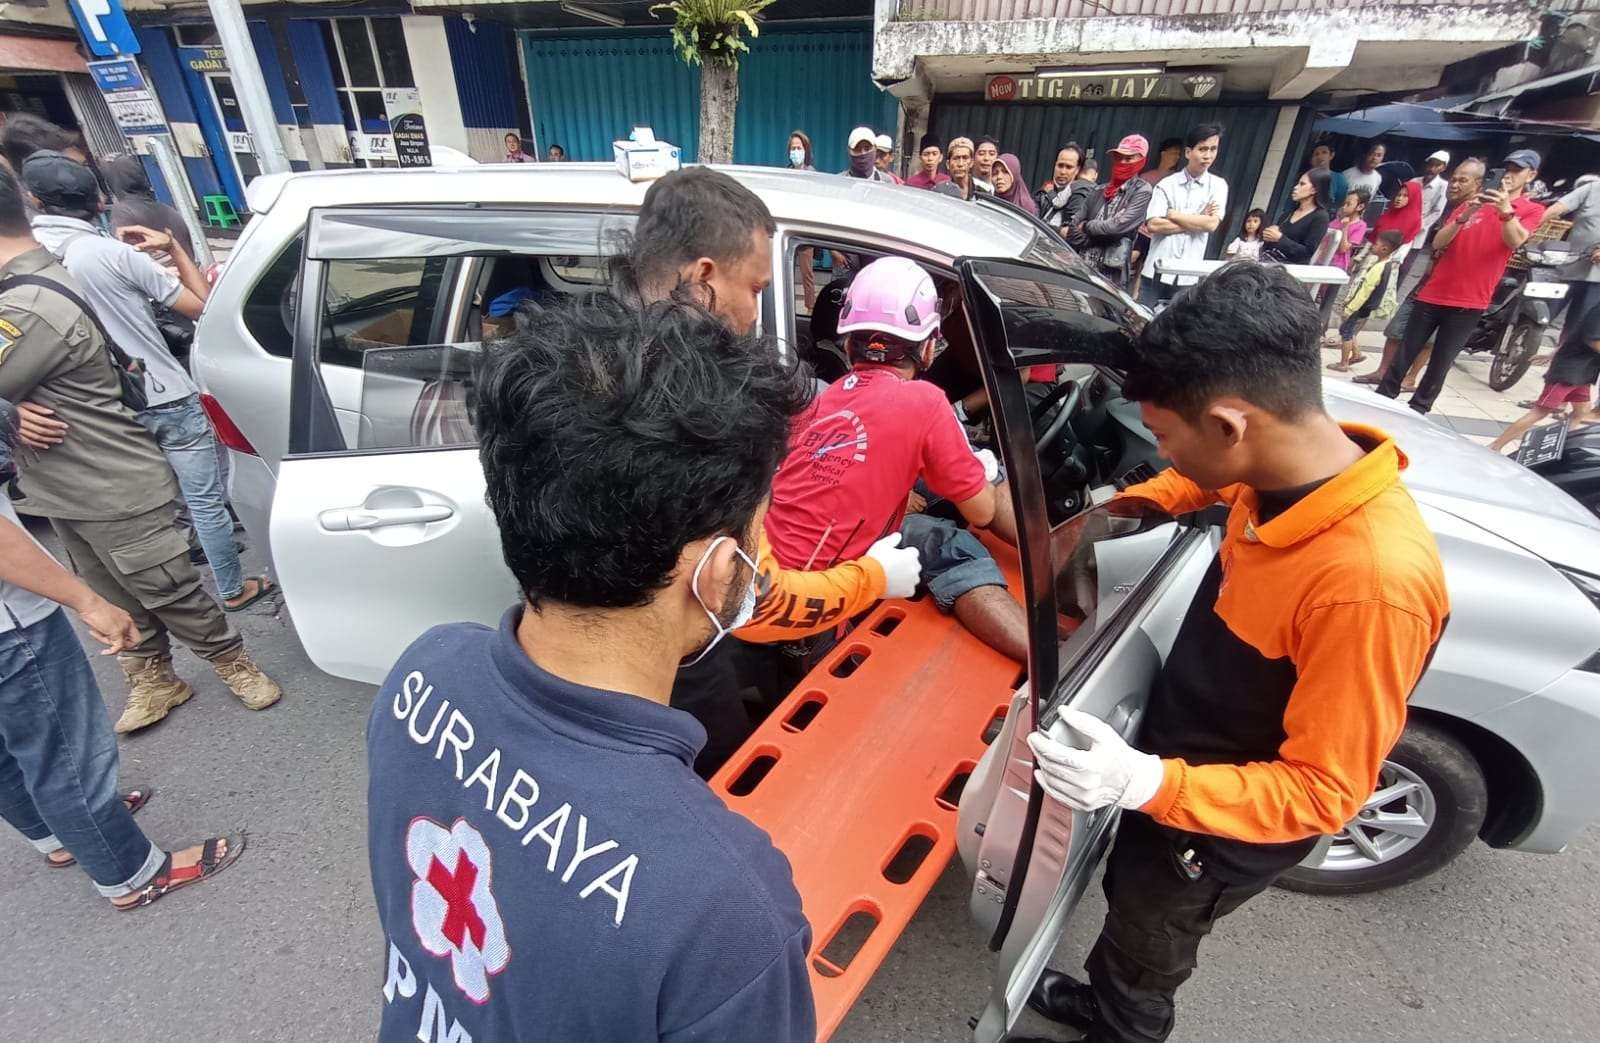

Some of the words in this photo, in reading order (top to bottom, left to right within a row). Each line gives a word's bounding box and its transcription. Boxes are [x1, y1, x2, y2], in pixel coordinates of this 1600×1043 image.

[78, 0, 111, 42] P
[190, 60, 223, 70] GADAI
[991, 82, 1013, 98] New
[1018, 79, 1080, 98] TIGA
[811, 461, 847, 477] Medical
[392, 670, 640, 927] SURABAYA
